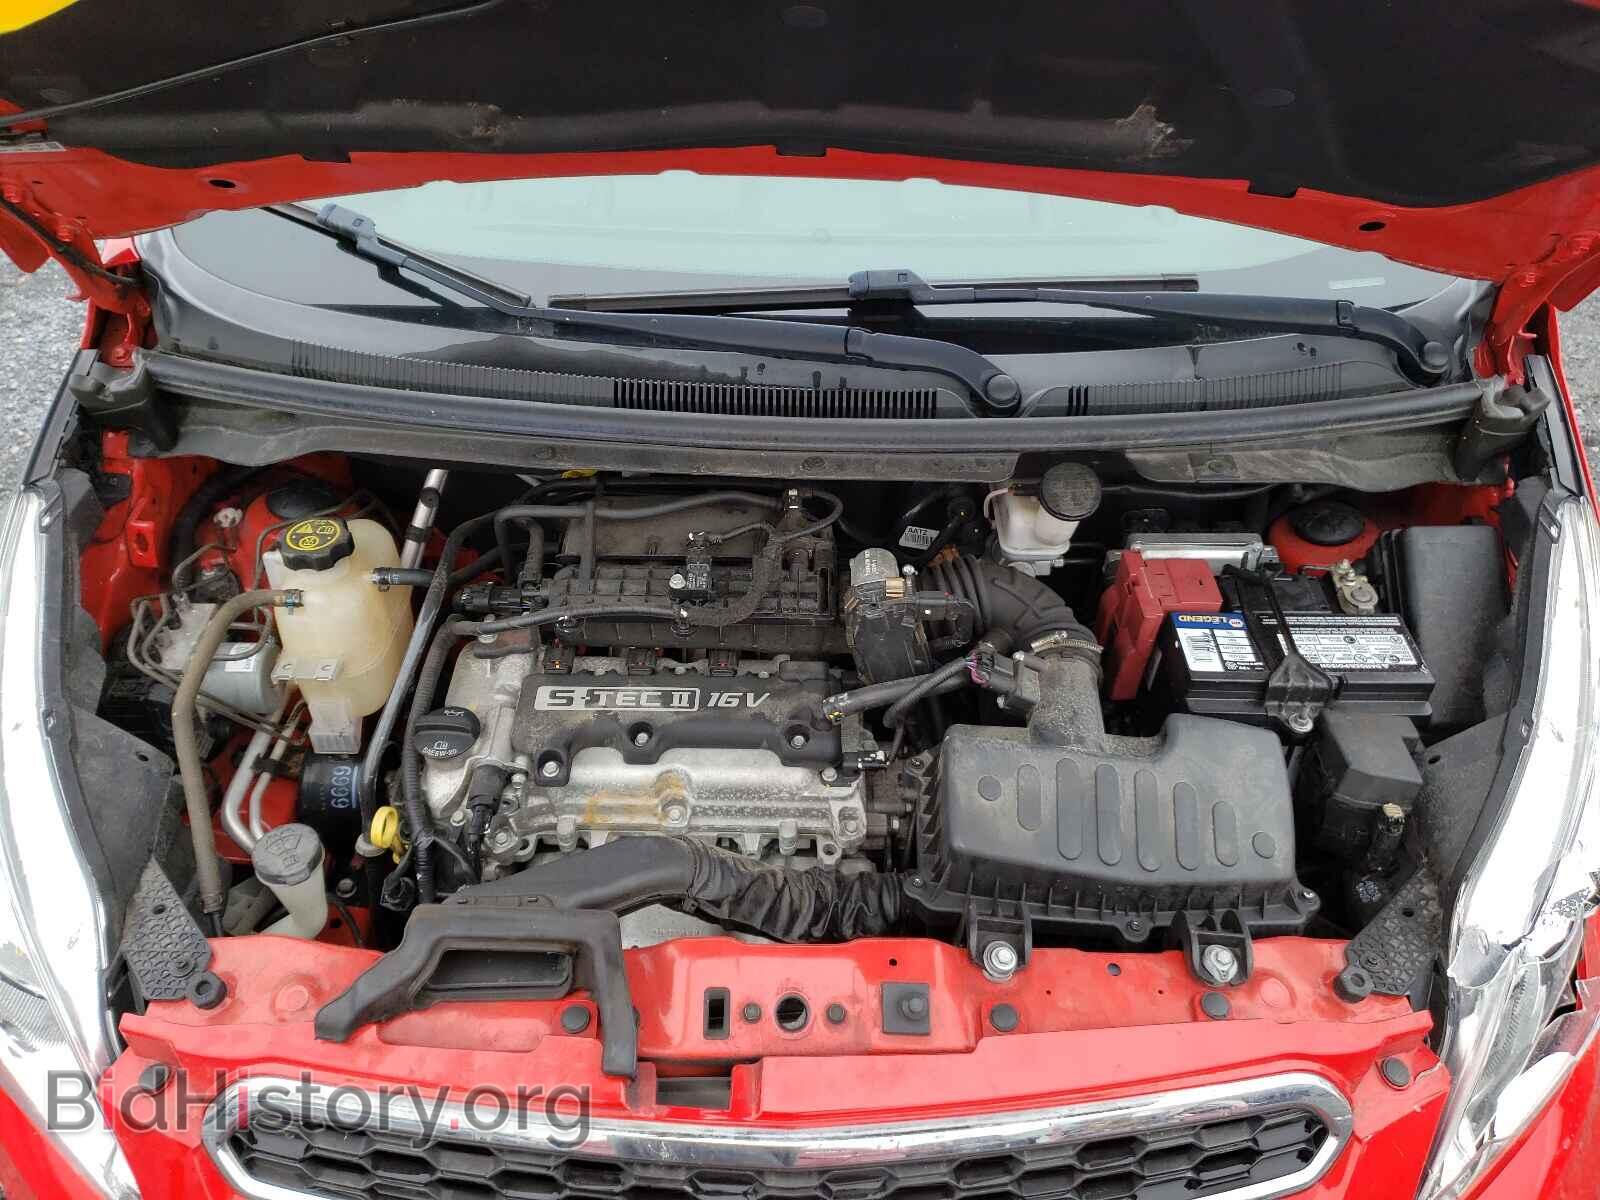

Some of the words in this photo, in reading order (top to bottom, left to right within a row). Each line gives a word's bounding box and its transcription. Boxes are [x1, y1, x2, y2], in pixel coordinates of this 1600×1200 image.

[1178, 615, 1228, 623] LEGEND
[706, 691, 772, 708] 16V
[331, 765, 352, 809] 6669
